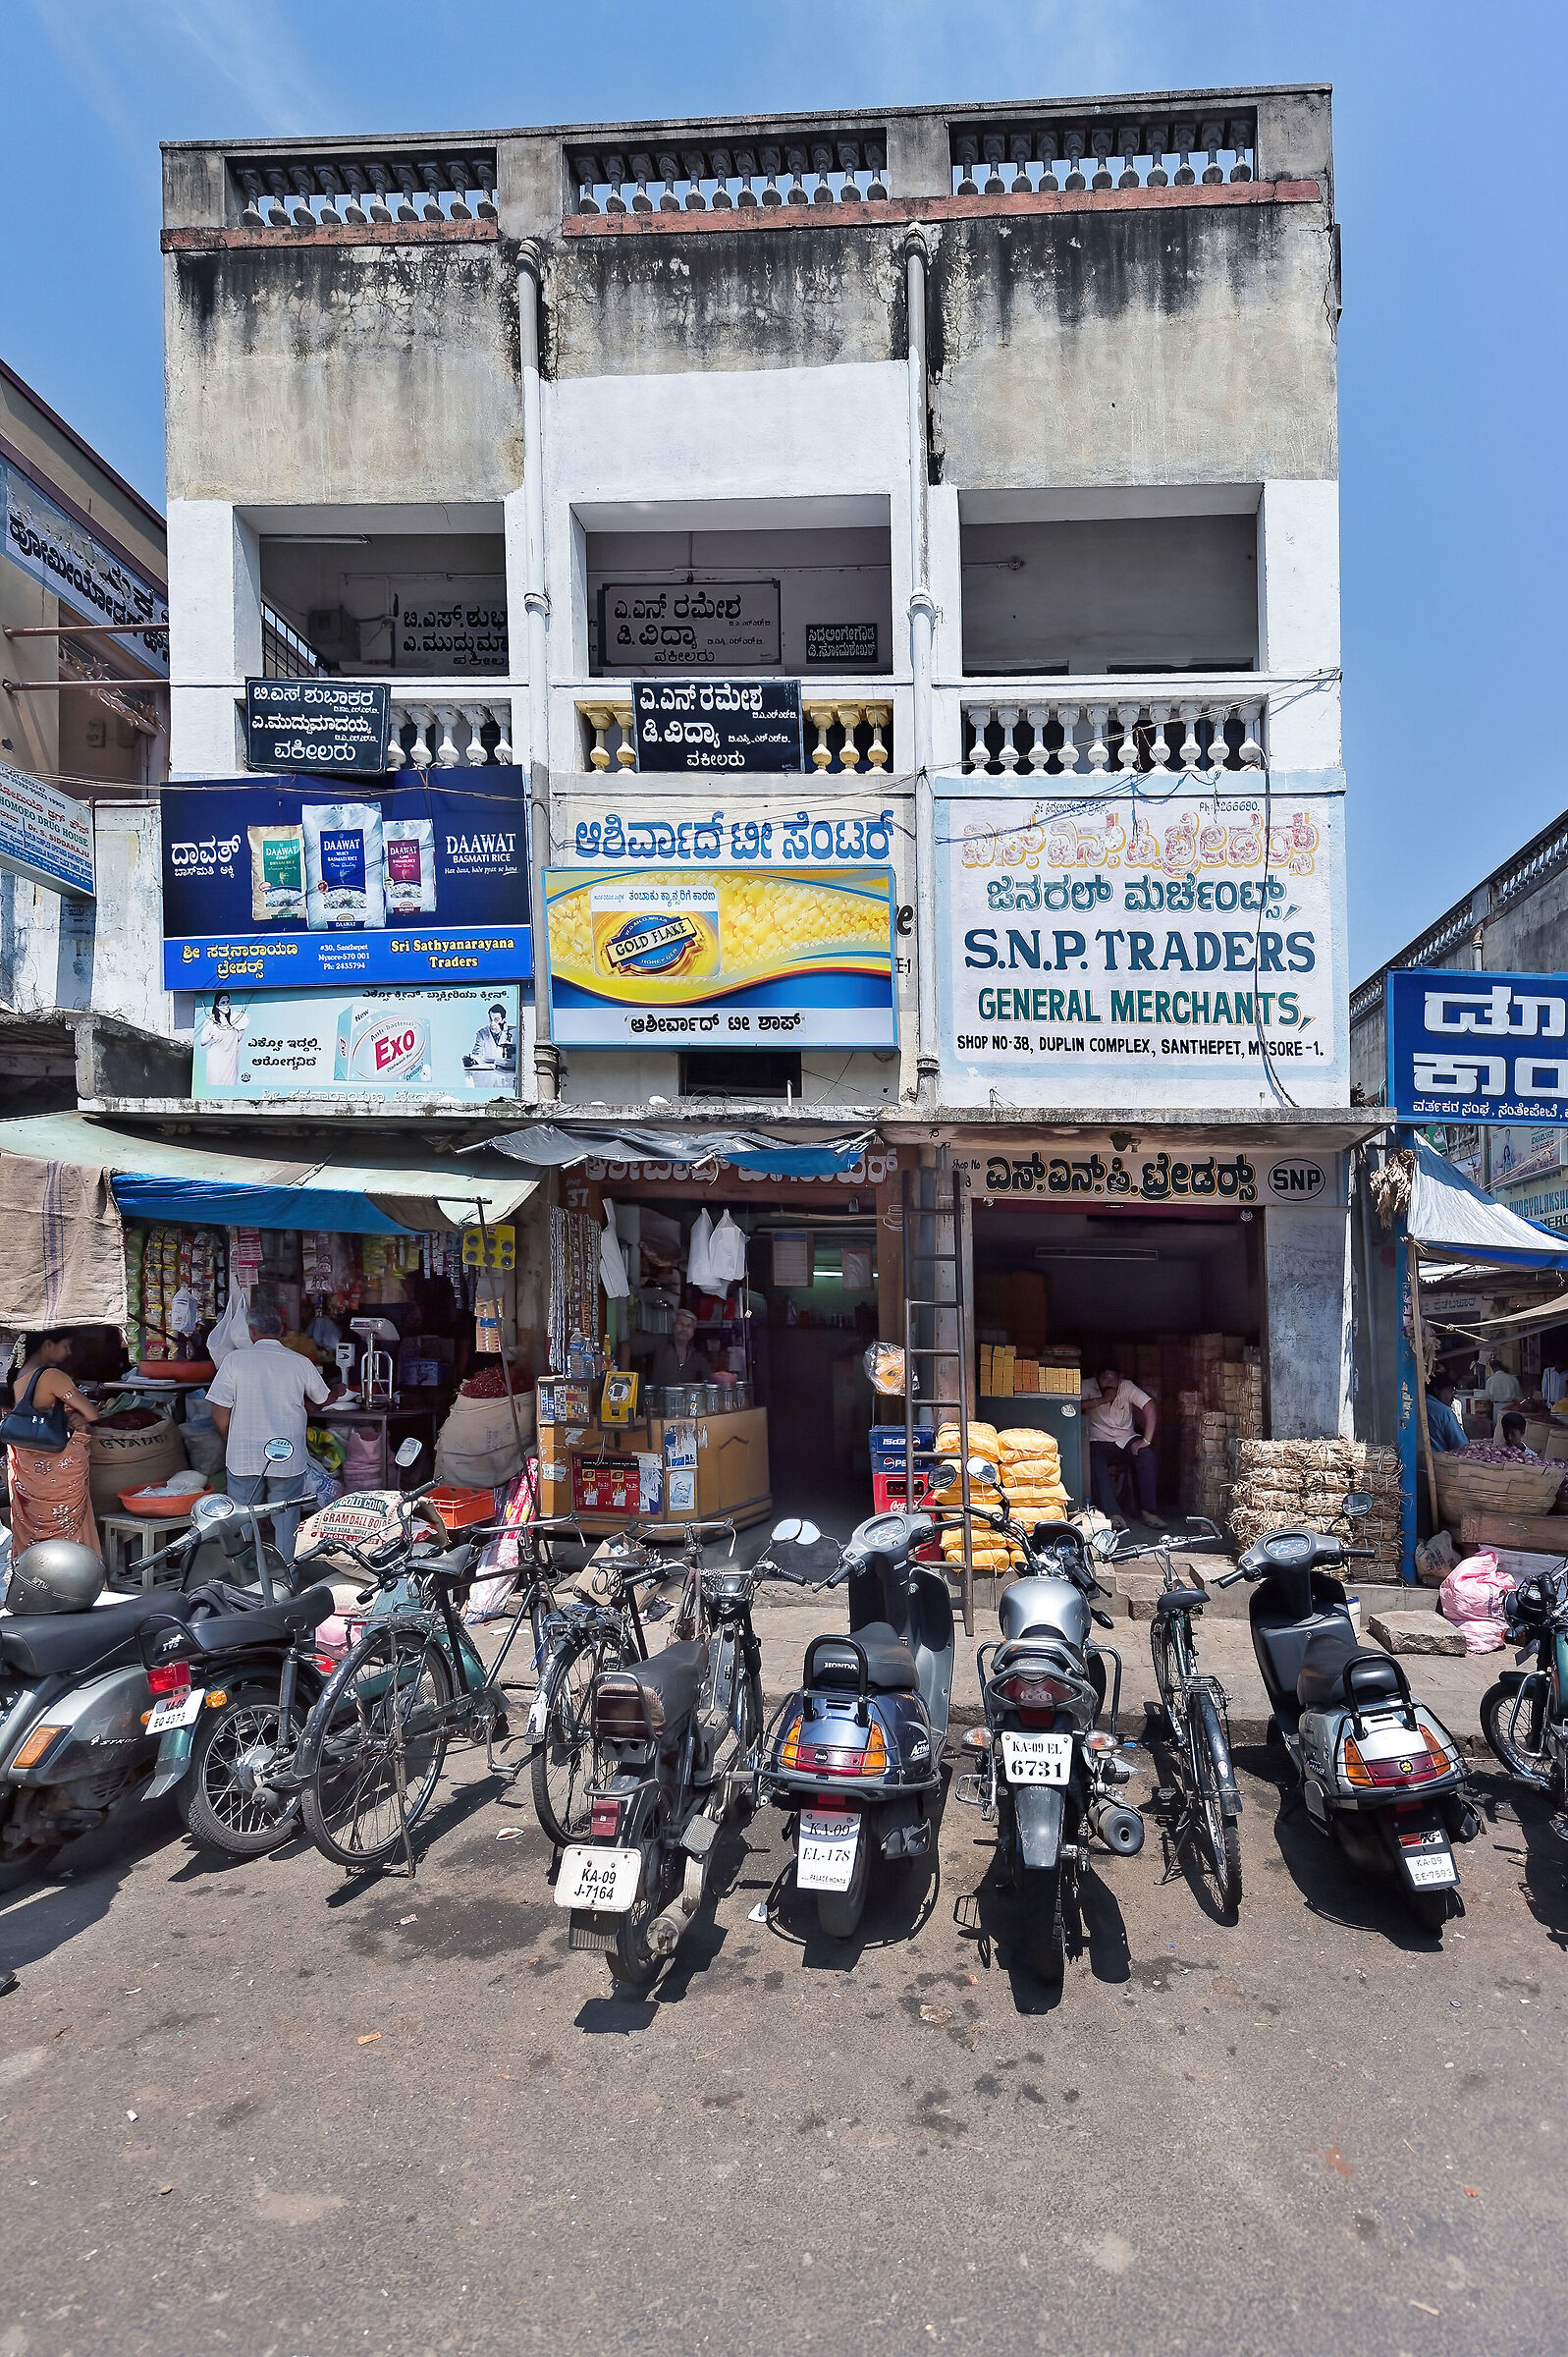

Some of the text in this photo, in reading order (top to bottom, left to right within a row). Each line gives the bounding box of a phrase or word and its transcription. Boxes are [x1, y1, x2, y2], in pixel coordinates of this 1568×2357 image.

[674, 591, 741, 620] ರಮೇಶ
[655, 649, 715, 662] ವಕೀಲರು
[304, 687, 374, 706] ಶುಭಾಕರ
[700, 683, 763, 711] ರಮೇಶ
[275, 740, 356, 760] ವಕೀಲರು
[687, 750, 745, 766] ವಕೀಲರು
[37, 814, 60, 833] DRUG
[63, 828, 88, 847] HOUSE
[731, 822, 773, 859] ಟೀ
[783, 810, 893, 859] ಸೆಂಟರ್
[171, 834, 241, 864] ದಾವತ್
[265, 847, 299, 856] DAAWAT
[323, 839, 360, 850] DAAWAT
[390, 847, 417, 855] DAAWAT
[446, 833, 516, 854] DAAWAT
[453, 854, 489, 863] BASMATI
[628, 890, 659, 901] ತಂಬಾಕು
[693, 890, 715, 901] ಕಾರಣ
[987, 874, 1113, 911] ಜನರಲ್
[392, 937, 514, 954] Sri Sathyanarayana
[616, 937, 649, 957] GOLD
[651, 922, 686, 943] FLAKE
[183, 941, 298, 963] ಶ್ರೀ ಸತ್ಯನಾರಾಯಣ
[964, 929, 1316, 972] S.N.P. TRADERS
[429, 956, 478, 968] Traders
[979, 987, 1102, 1023] GENERAL
[354, 1010, 369, 1021] New
[631, 1013, 801, 1031] ಆಶೀರ್ವಾದ್ ಟೀ ಶಾಪ್
[247, 1038, 284, 1052] ಎಕ್ಸೋ
[957, 1035, 988, 1049] SHOP
[1039, 1036, 1084, 1052] DUPLIN
[1089, 1037, 1156, 1058] COMPLEX,
[1162, 1039, 1245, 1059] SANTHEPET,
[1273, 1168, 1321, 1191] SNP
[568, 1188, 589, 1207] 37
[340, 1497, 384, 1510] GOLD COIN
[322, 1512, 349, 1523] GRAM
[1048, 1743, 1062, 1754] EL
[1011, 1760, 1062, 1778] 6731
[809, 1823, 850, 1836] KA-09
[803, 1848, 850, 1861] EL-178
[1416, 1856, 1442, 1867] KA-09
[581, 1869, 617, 1885] KA-09
[574, 1885, 614, 1900] J-7164
